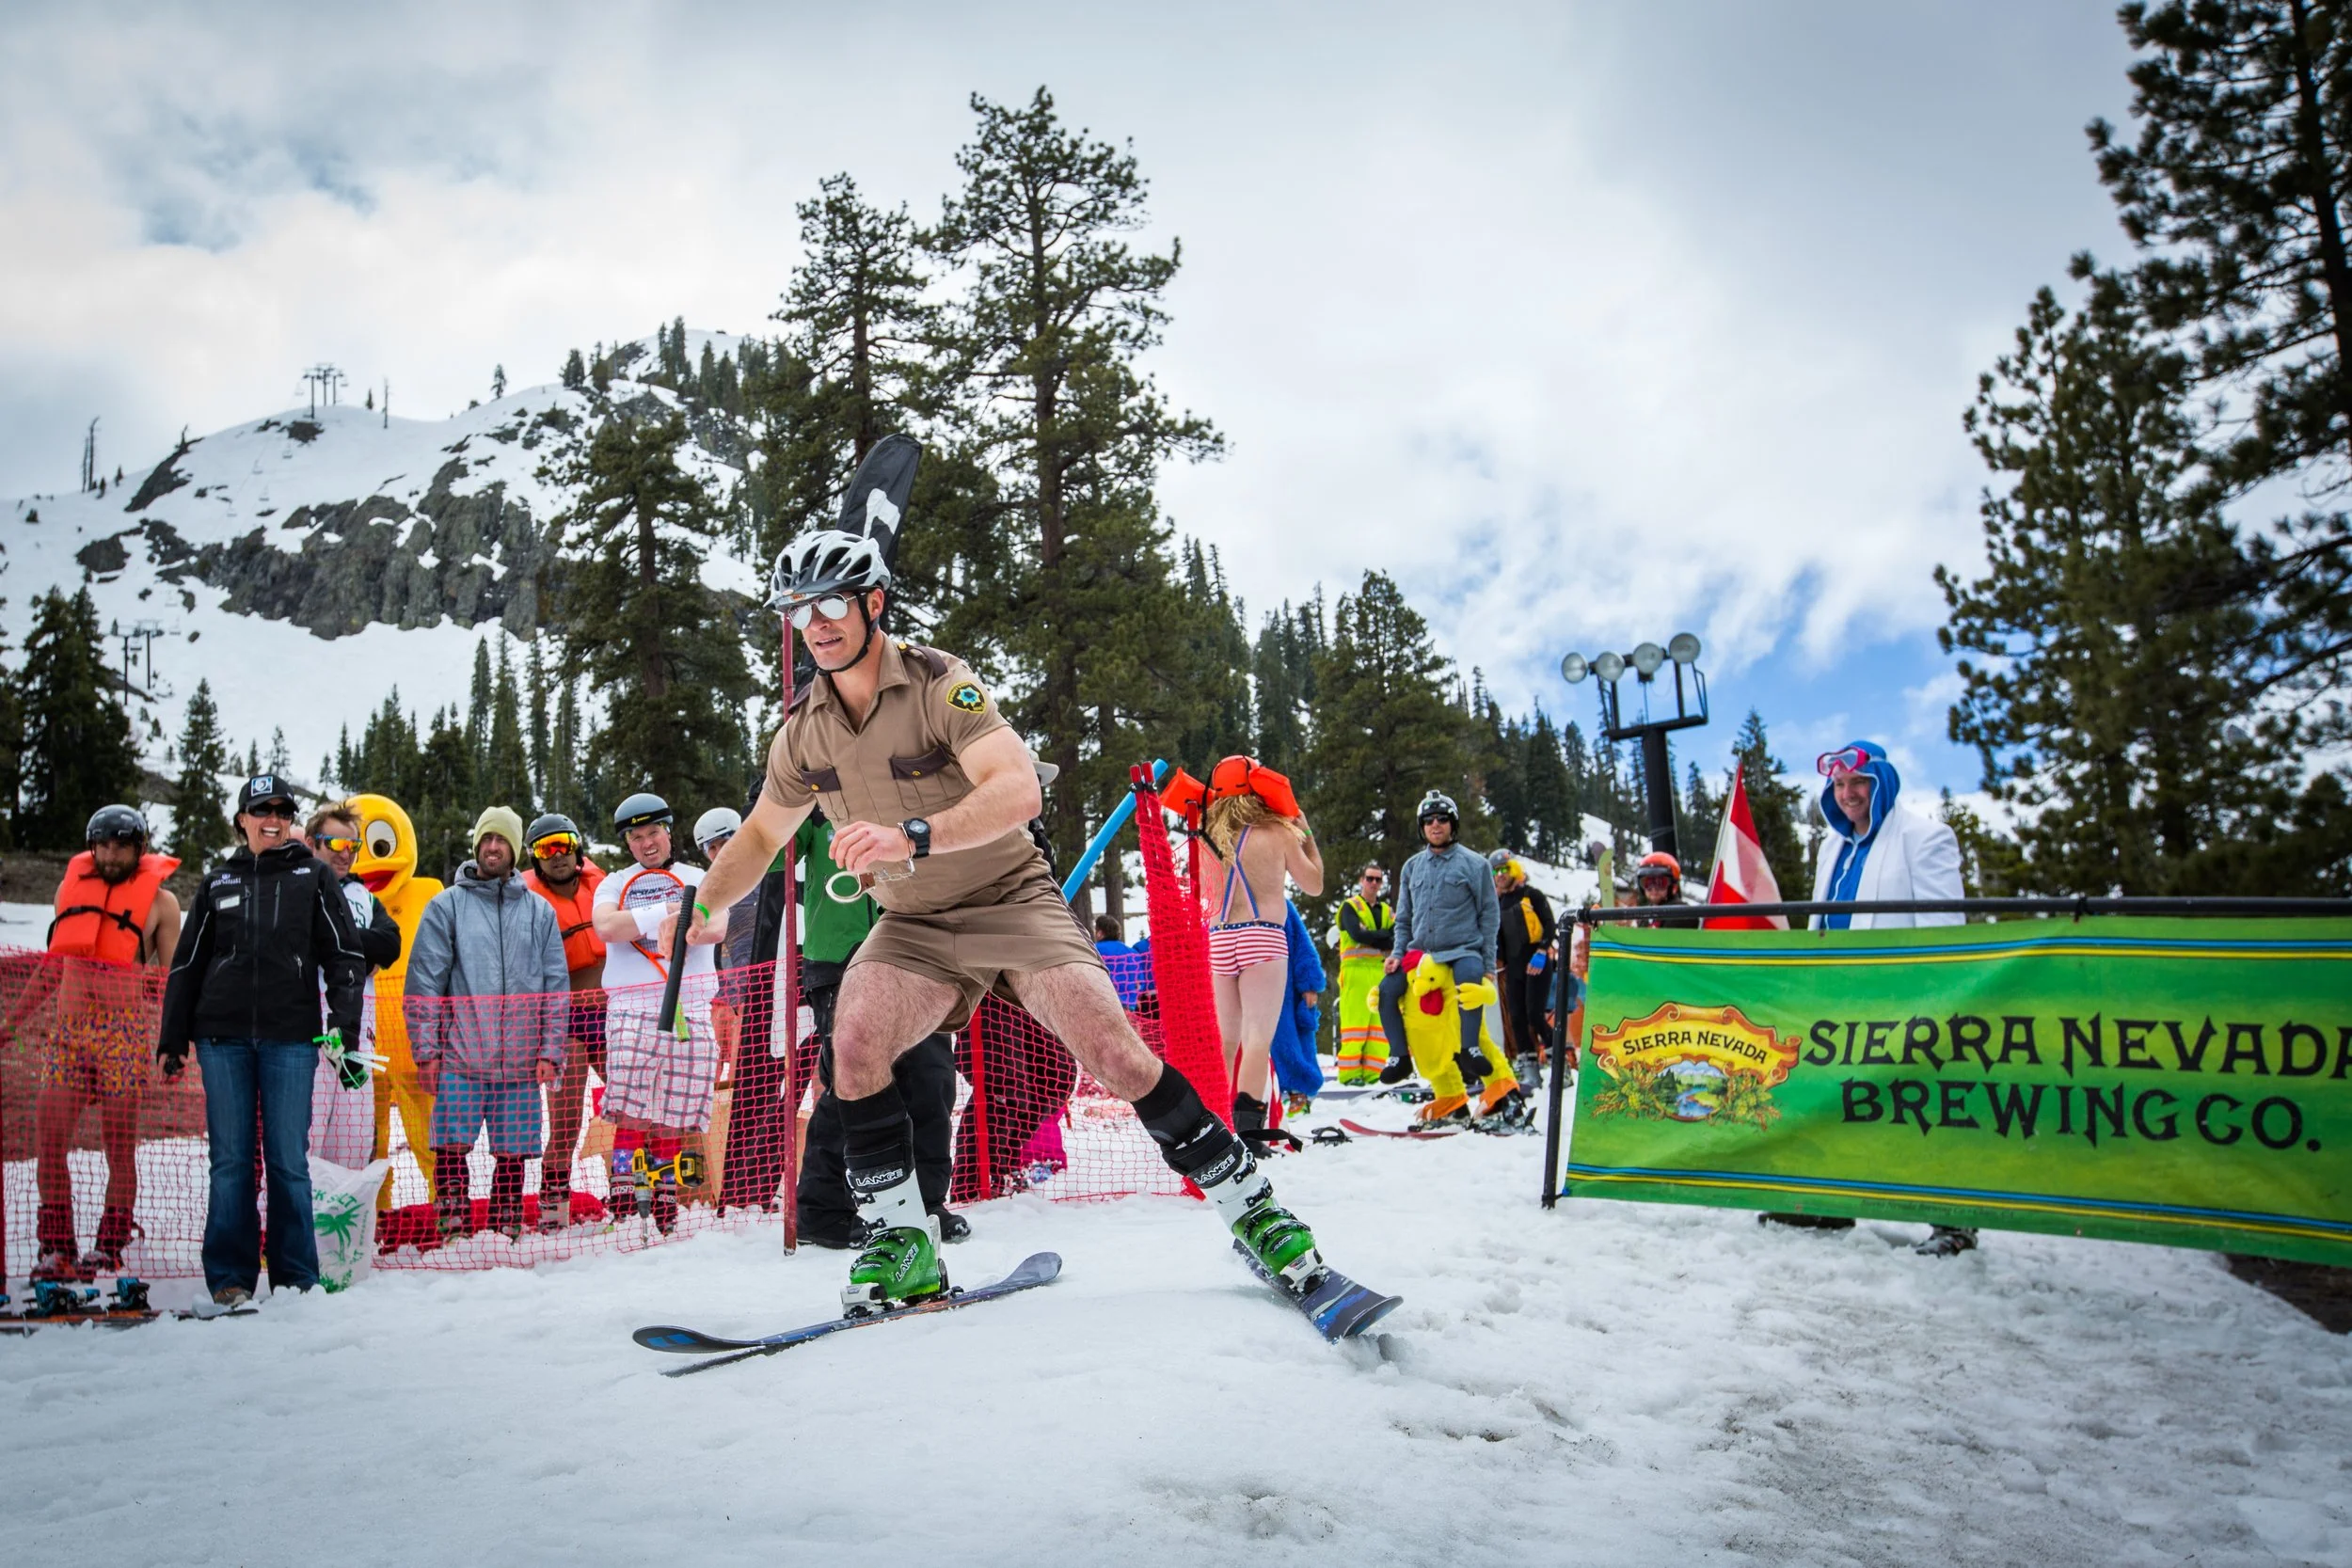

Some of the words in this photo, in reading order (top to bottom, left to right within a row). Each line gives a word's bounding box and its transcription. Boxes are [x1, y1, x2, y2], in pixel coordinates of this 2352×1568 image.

[1623, 1031, 1692, 1055] SIERRA
[1696, 1030, 1768, 1064] NEVADA
[1802, 1012, 2043, 1074] SIERRA
[1839, 1076, 2182, 1149] BREWING
[2195, 1092, 2322, 1152] CO.
[855, 1167, 904, 1187] LANGE
[1193, 1153, 1236, 1185] LANGE
[895, 1242, 920, 1282] LANGE
